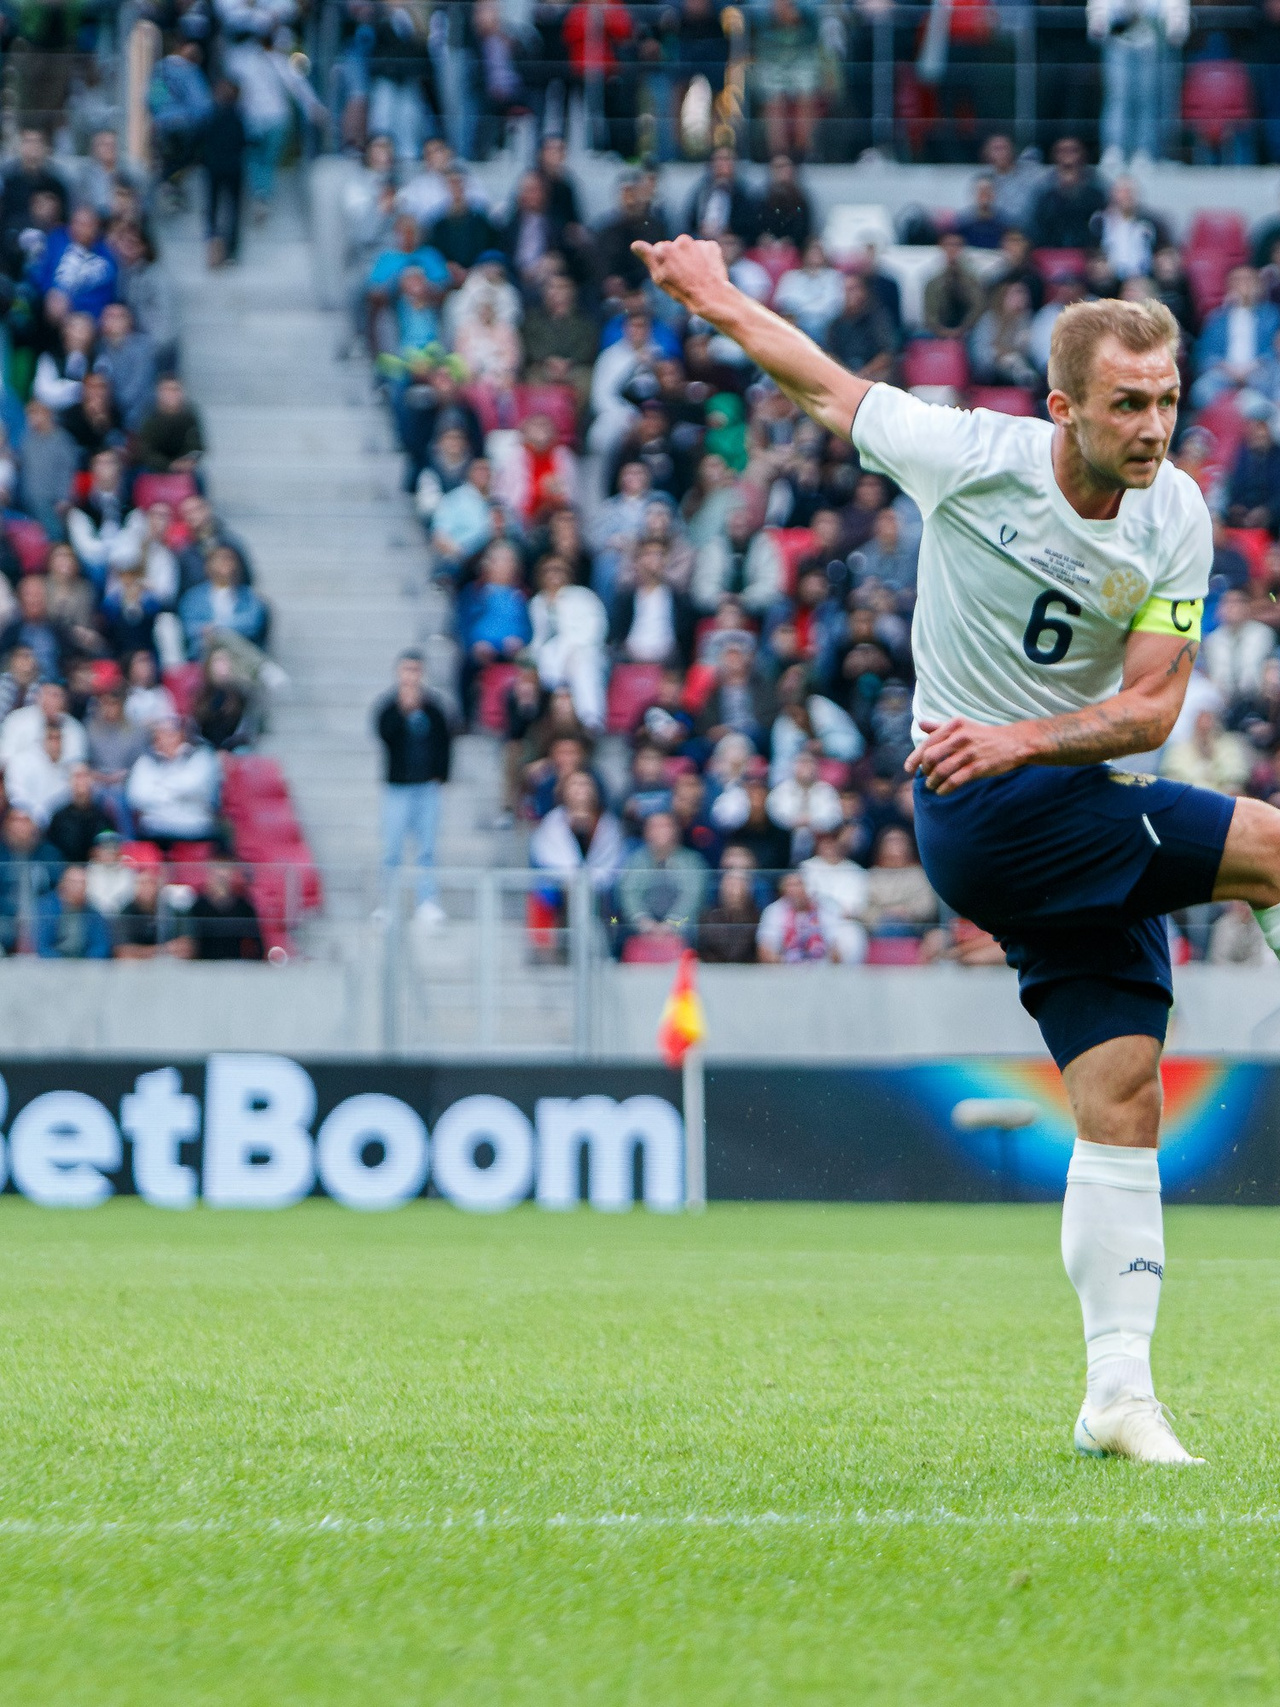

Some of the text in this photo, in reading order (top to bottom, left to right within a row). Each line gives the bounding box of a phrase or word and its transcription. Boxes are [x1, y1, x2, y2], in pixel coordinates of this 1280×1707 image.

[1023, 589, 1081, 664] 6
[1171, 599, 1195, 632] C
[0, 1053, 686, 1212] etBoom
